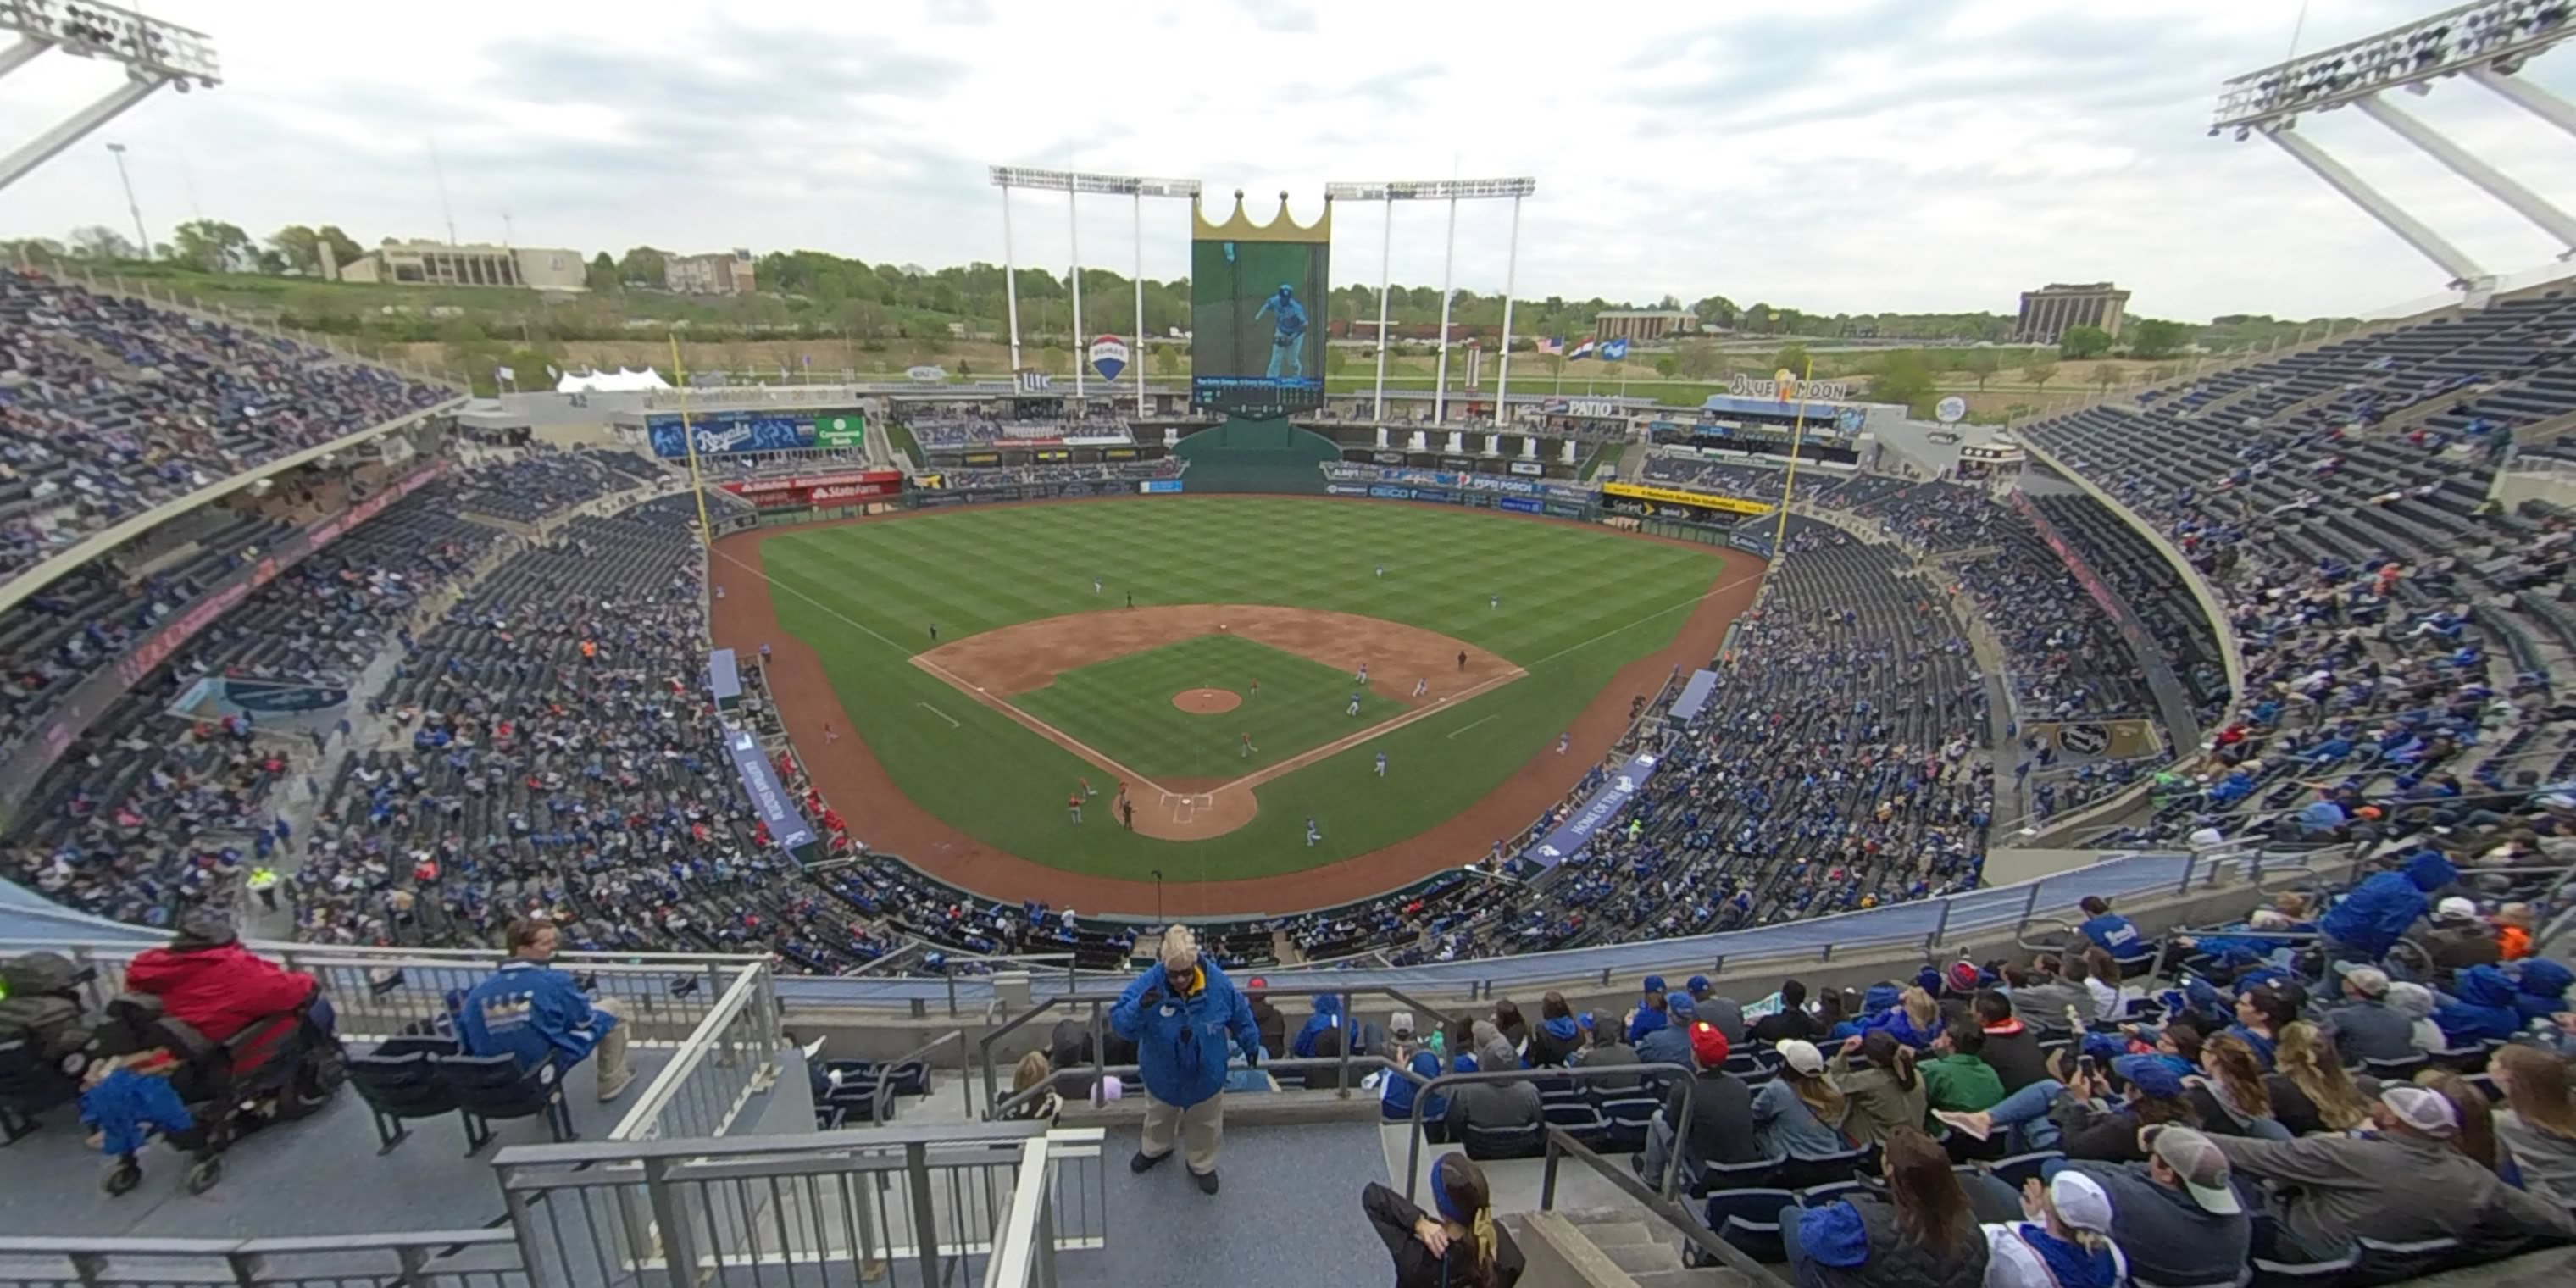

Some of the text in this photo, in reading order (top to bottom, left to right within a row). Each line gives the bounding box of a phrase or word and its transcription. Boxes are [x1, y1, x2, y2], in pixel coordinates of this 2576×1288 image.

[1796, 380, 1846, 400] MOON
[1568, 401, 1611, 418] PATIO
[697, 421, 751, 452] Royals
[1370, 486, 1408, 498] GEICO
[1613, 499, 1642, 515] Sprint
[1570, 812, 1601, 836] HOME
[1593, 802, 1609, 813] OF
